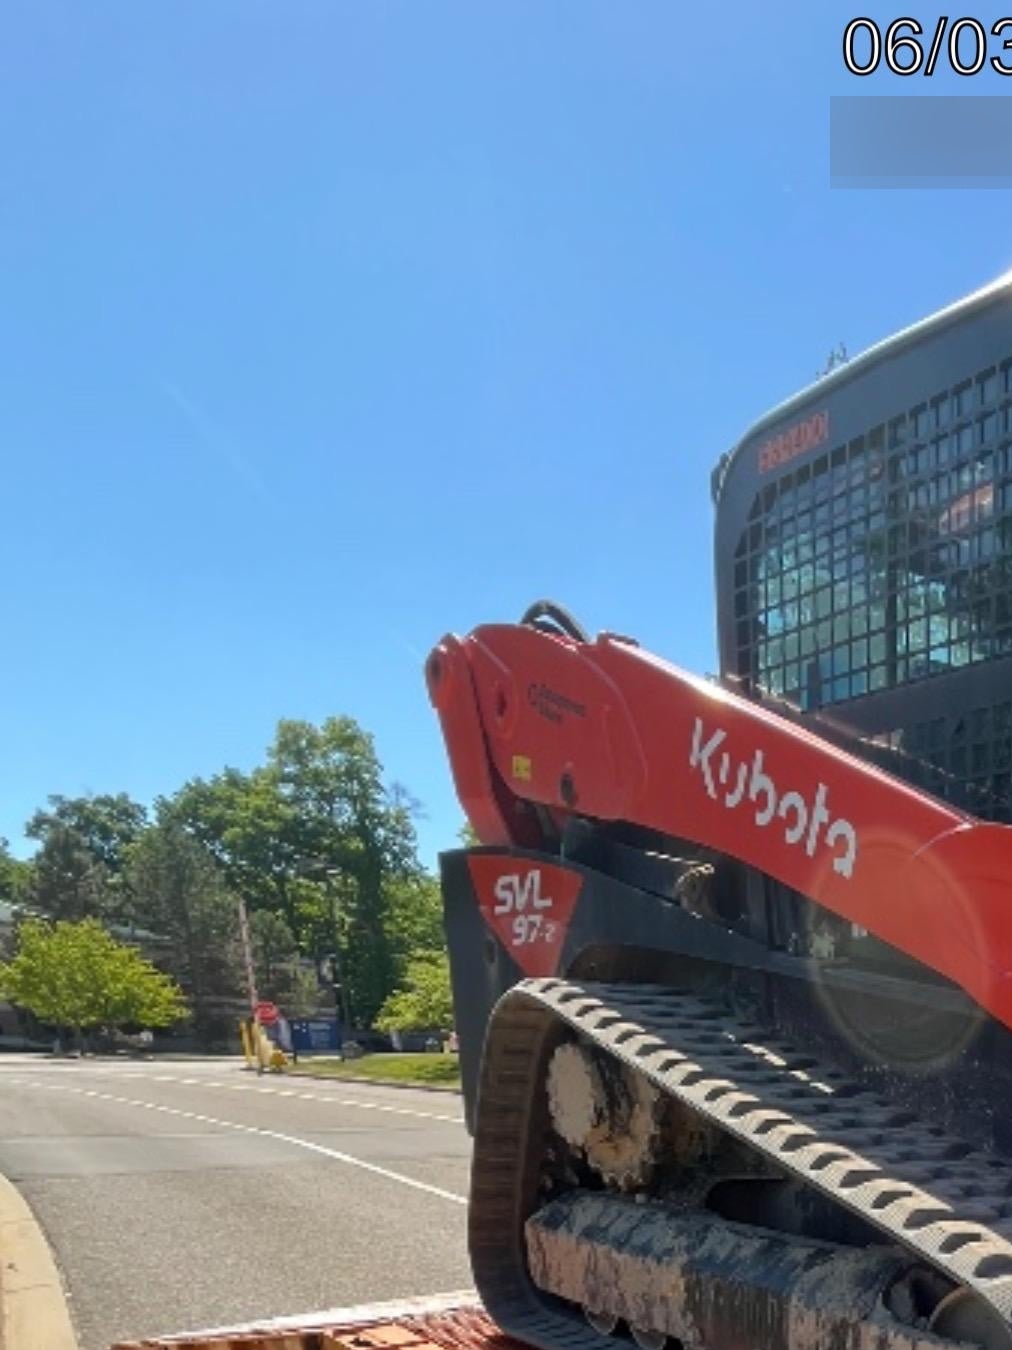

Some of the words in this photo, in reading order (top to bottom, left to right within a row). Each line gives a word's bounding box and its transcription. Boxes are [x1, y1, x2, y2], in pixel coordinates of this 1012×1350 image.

[689, 716, 857, 880] Kubota
[494, 869, 552, 915] SVL
[512, 914, 556, 946] 97-2
